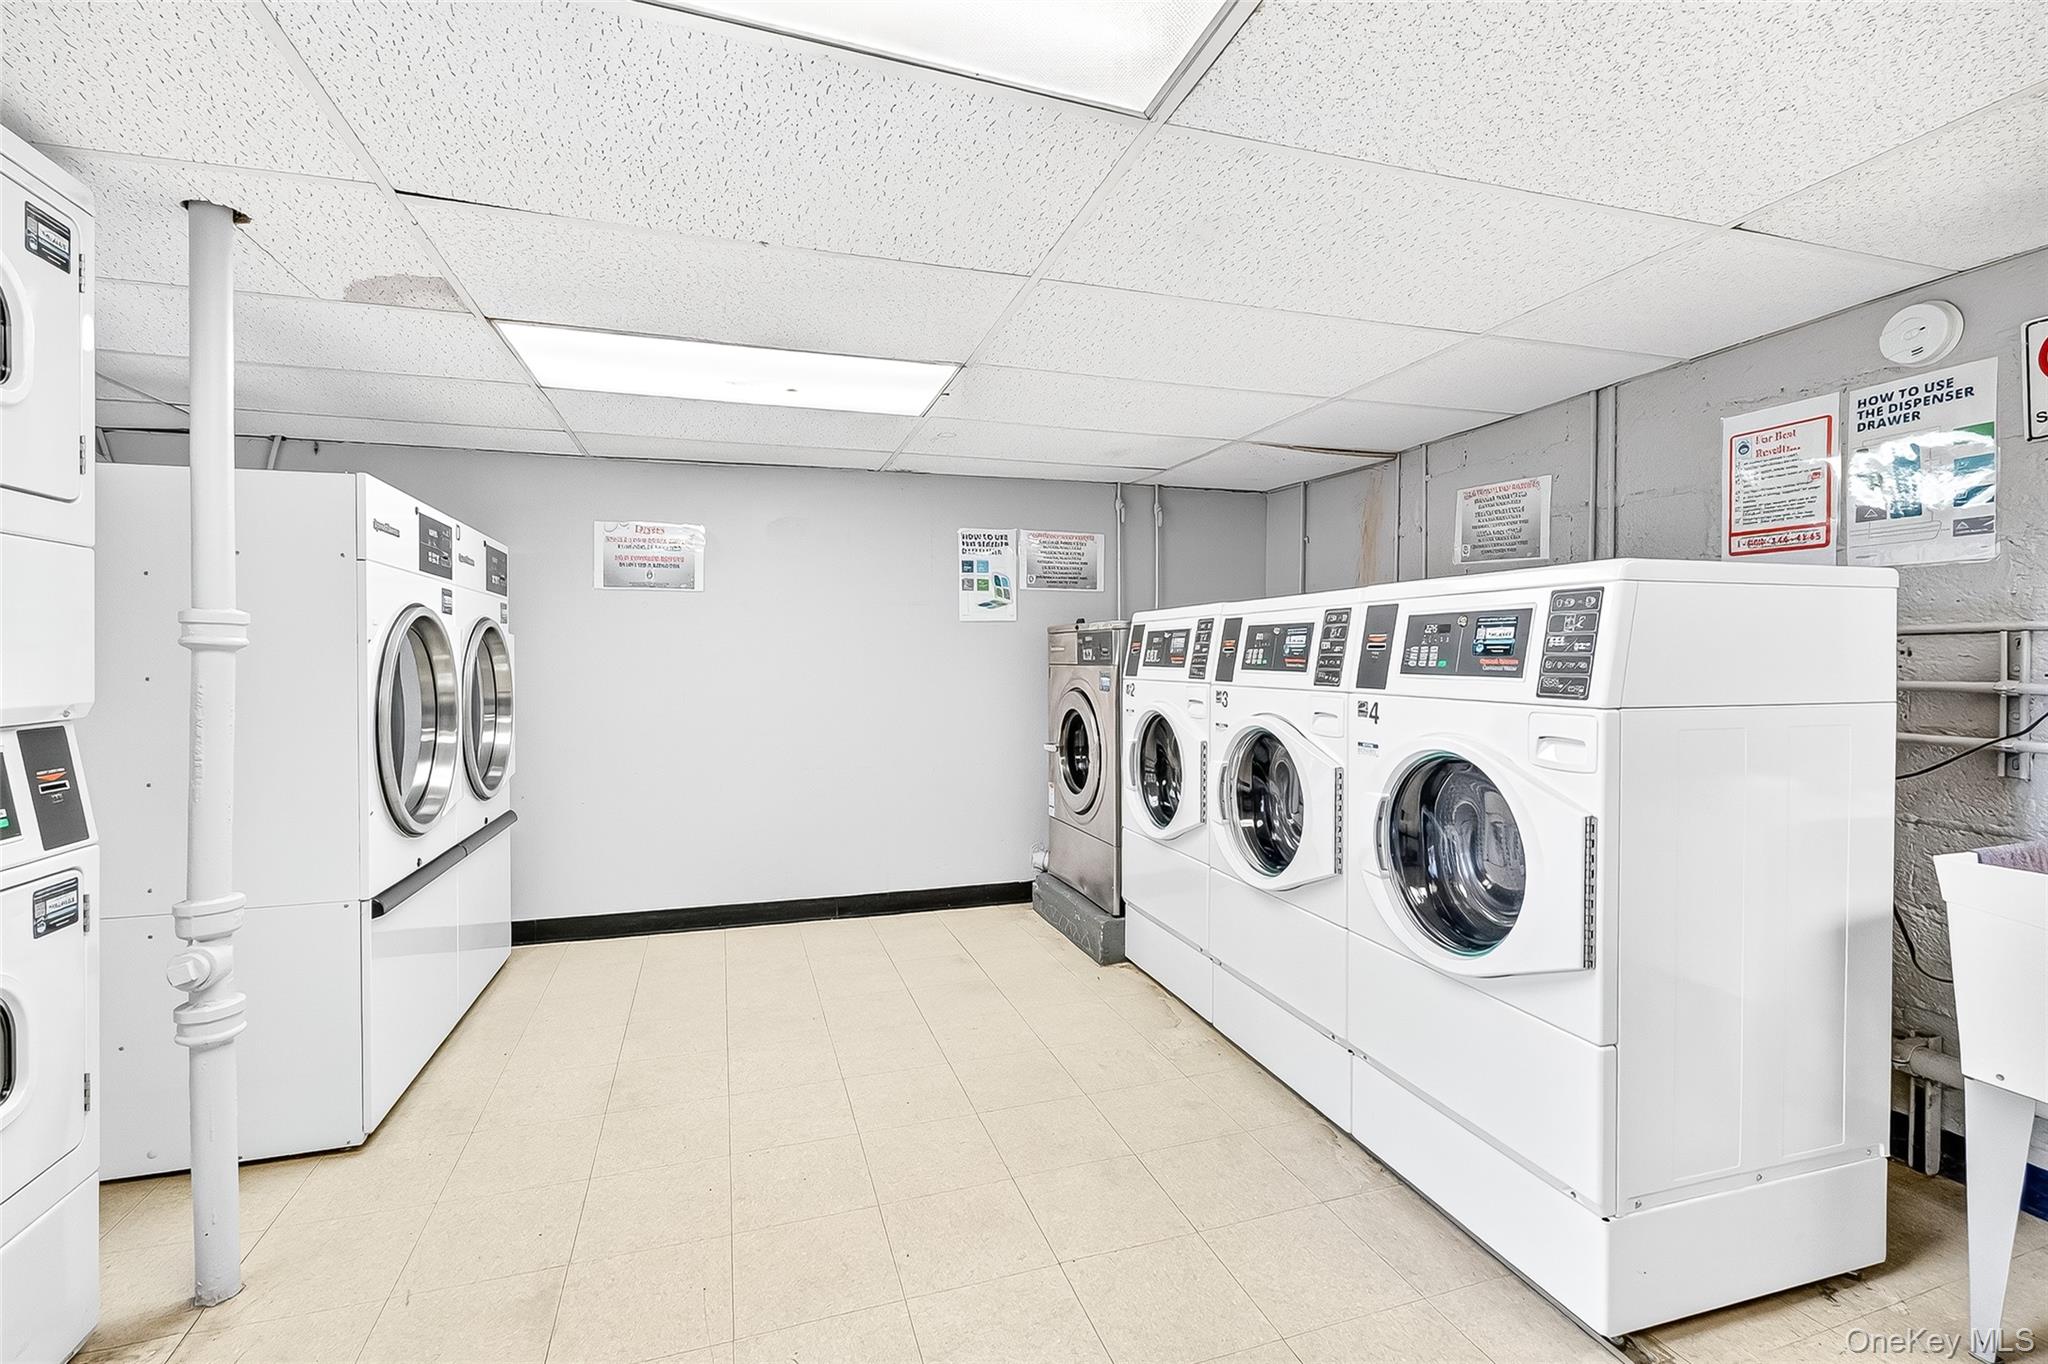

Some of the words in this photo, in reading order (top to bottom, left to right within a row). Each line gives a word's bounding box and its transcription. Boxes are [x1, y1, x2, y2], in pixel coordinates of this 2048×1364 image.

[1856, 405, 1884, 421] THE
[1888, 385, 1975, 414] DISPENSER
[1857, 390, 1895, 410] HOW
[1899, 386, 1920, 400] TO
[1925, 376, 1955, 393] USE
[1856, 410, 1922, 433] DRAWER
[1221, 690, 1229, 708] 3
[1369, 701, 1380, 725] 4
